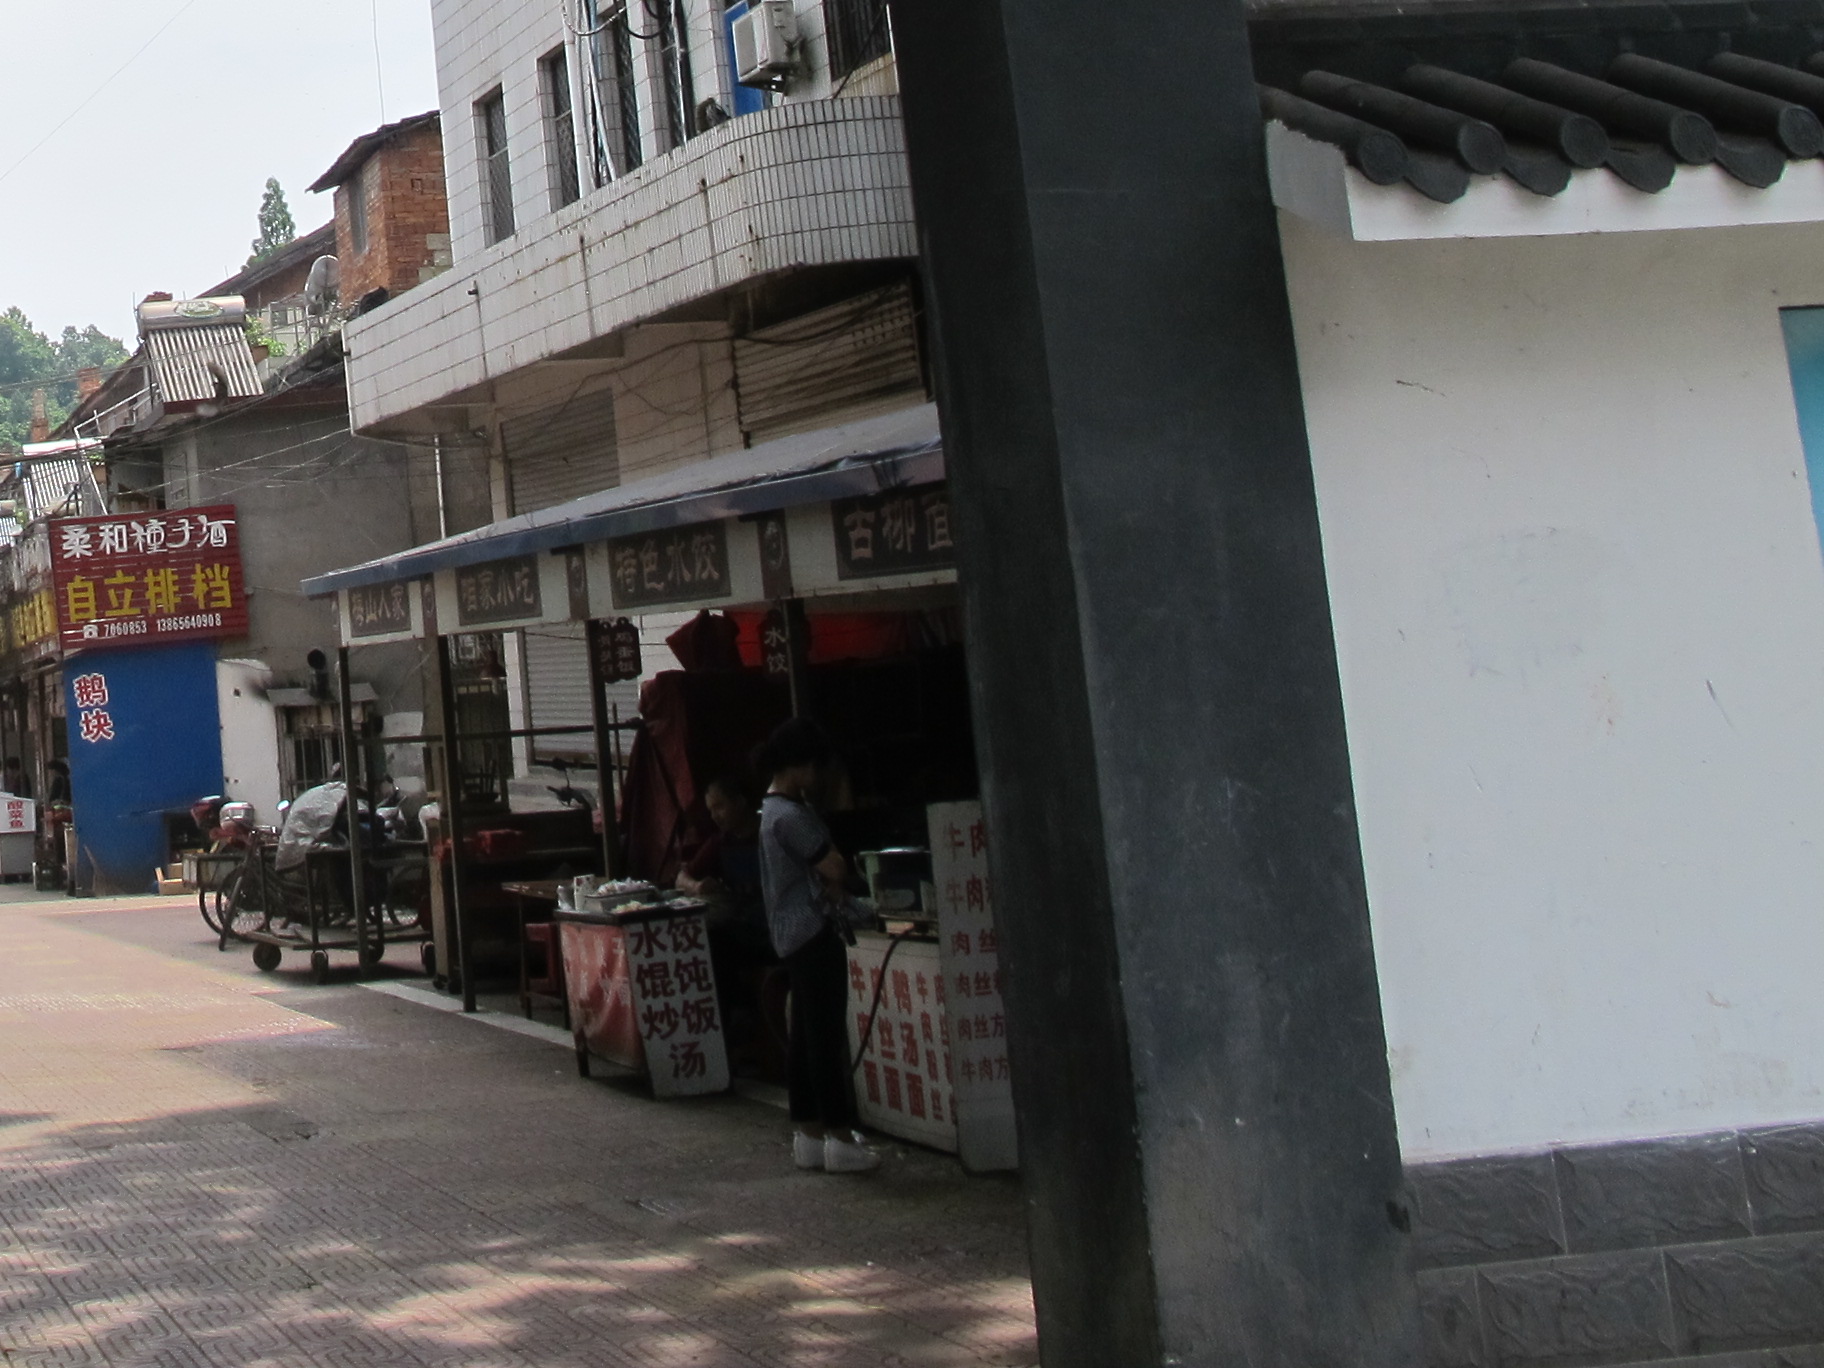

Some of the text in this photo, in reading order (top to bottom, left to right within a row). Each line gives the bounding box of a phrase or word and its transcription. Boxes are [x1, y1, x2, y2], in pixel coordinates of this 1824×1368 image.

[615, 531, 720, 594] 特色水饺
[67, 563, 232, 623] 自立排档
[103, 613, 222, 638] 7060853 13865640908
[764, 626, 789, 674] 水饺
[73, 673, 115, 743] 鹅块
[630, 916, 705, 959] 水饺
[636, 957, 713, 1000] 馄饨
[642, 997, 719, 1040] 炒饭
[669, 1041, 707, 1078] 汤
